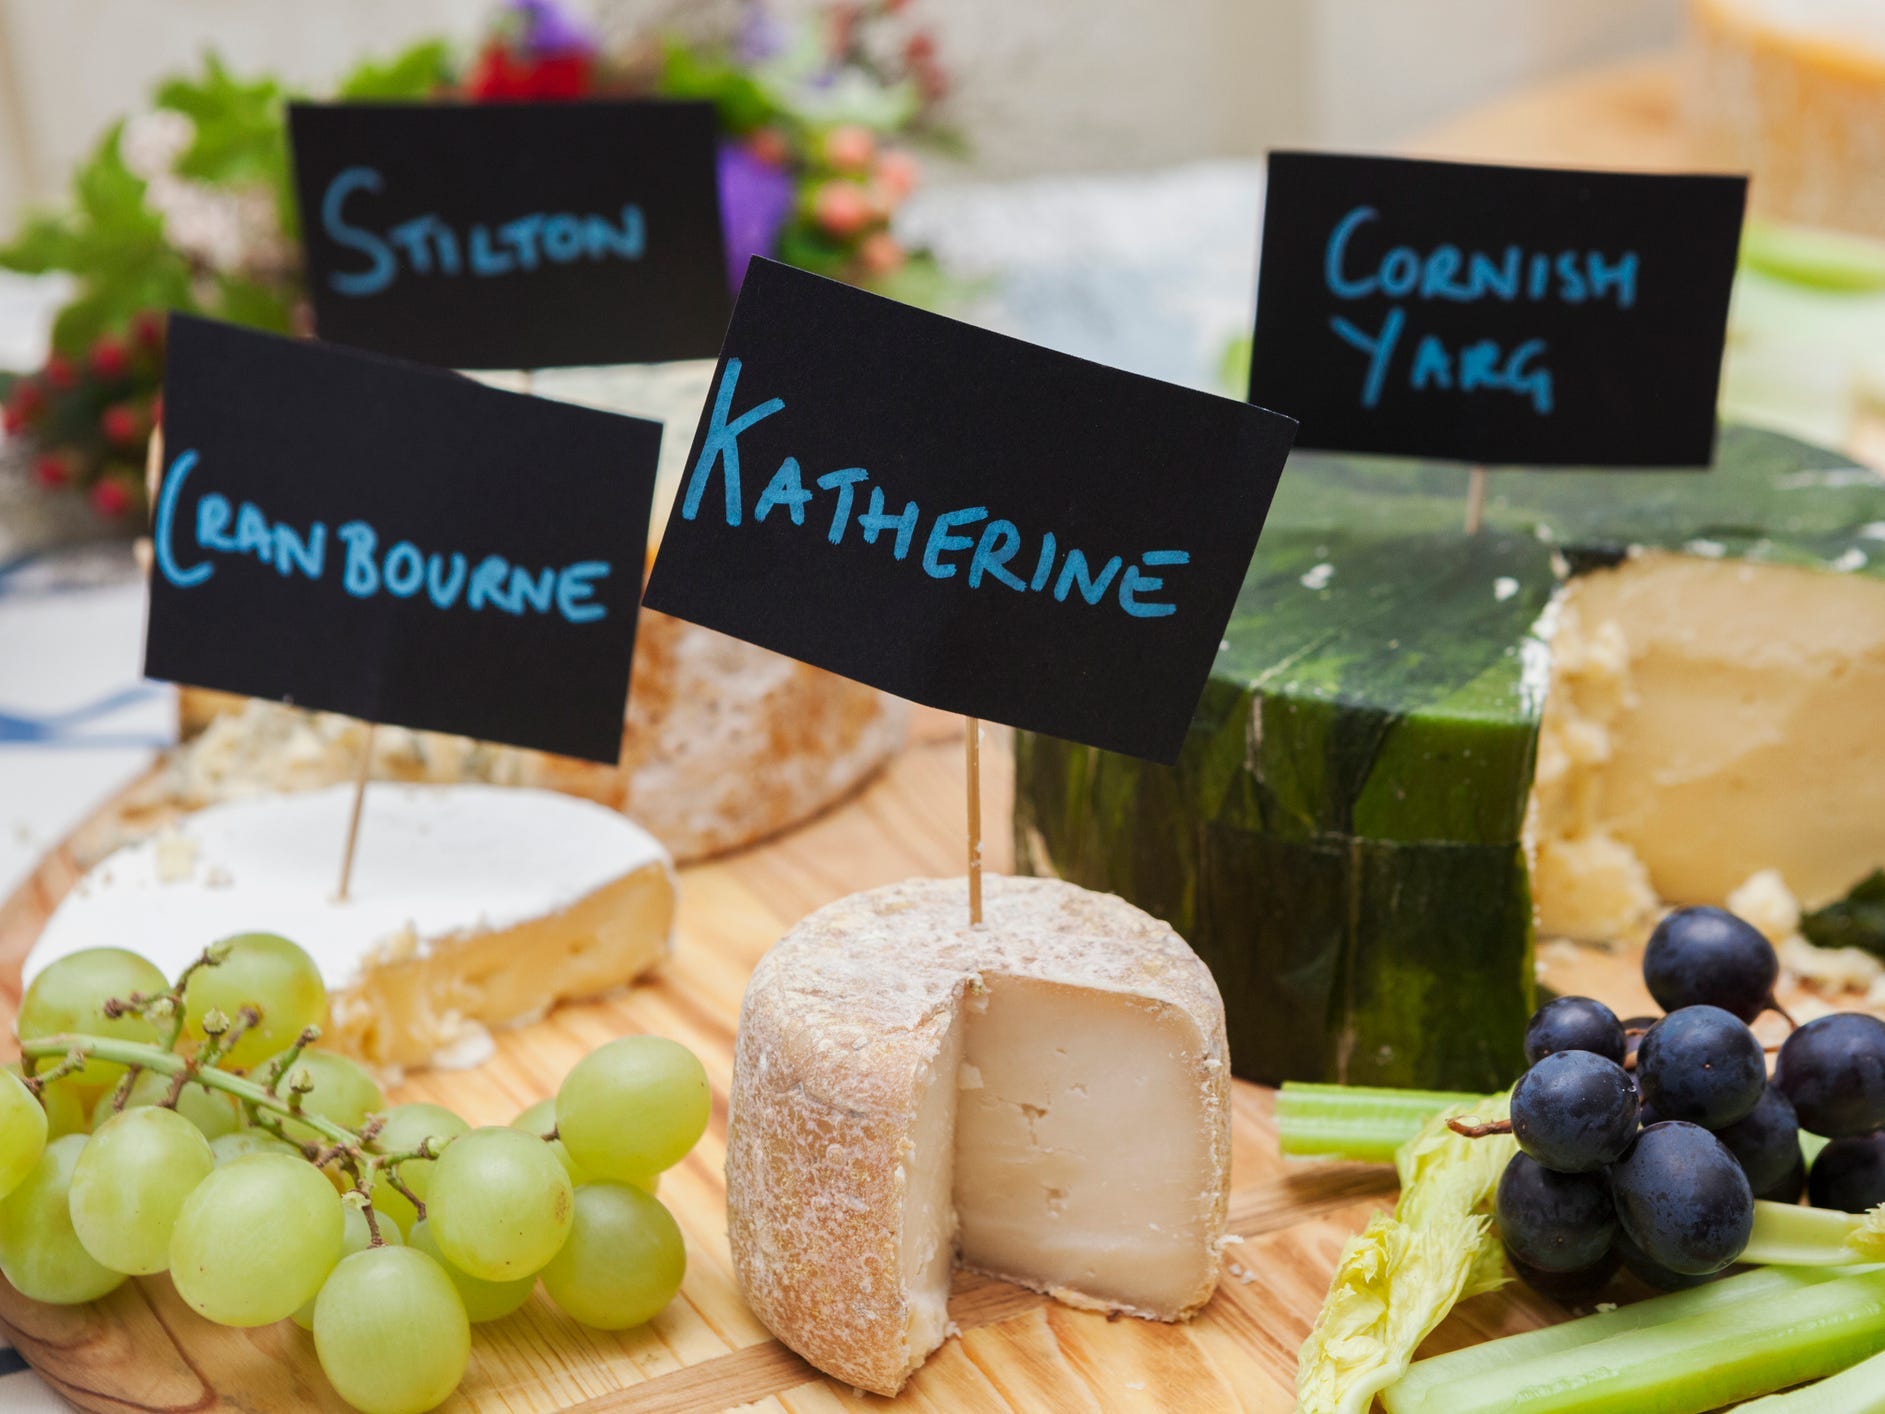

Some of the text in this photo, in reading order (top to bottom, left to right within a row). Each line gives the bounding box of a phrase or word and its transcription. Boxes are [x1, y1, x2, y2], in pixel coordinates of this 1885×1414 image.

[322, 167, 646, 295] STILTON
[1324, 205, 1639, 307] CORNISH
[1330, 307, 1553, 414] YARG
[682, 357, 1190, 617] KATHERINE
